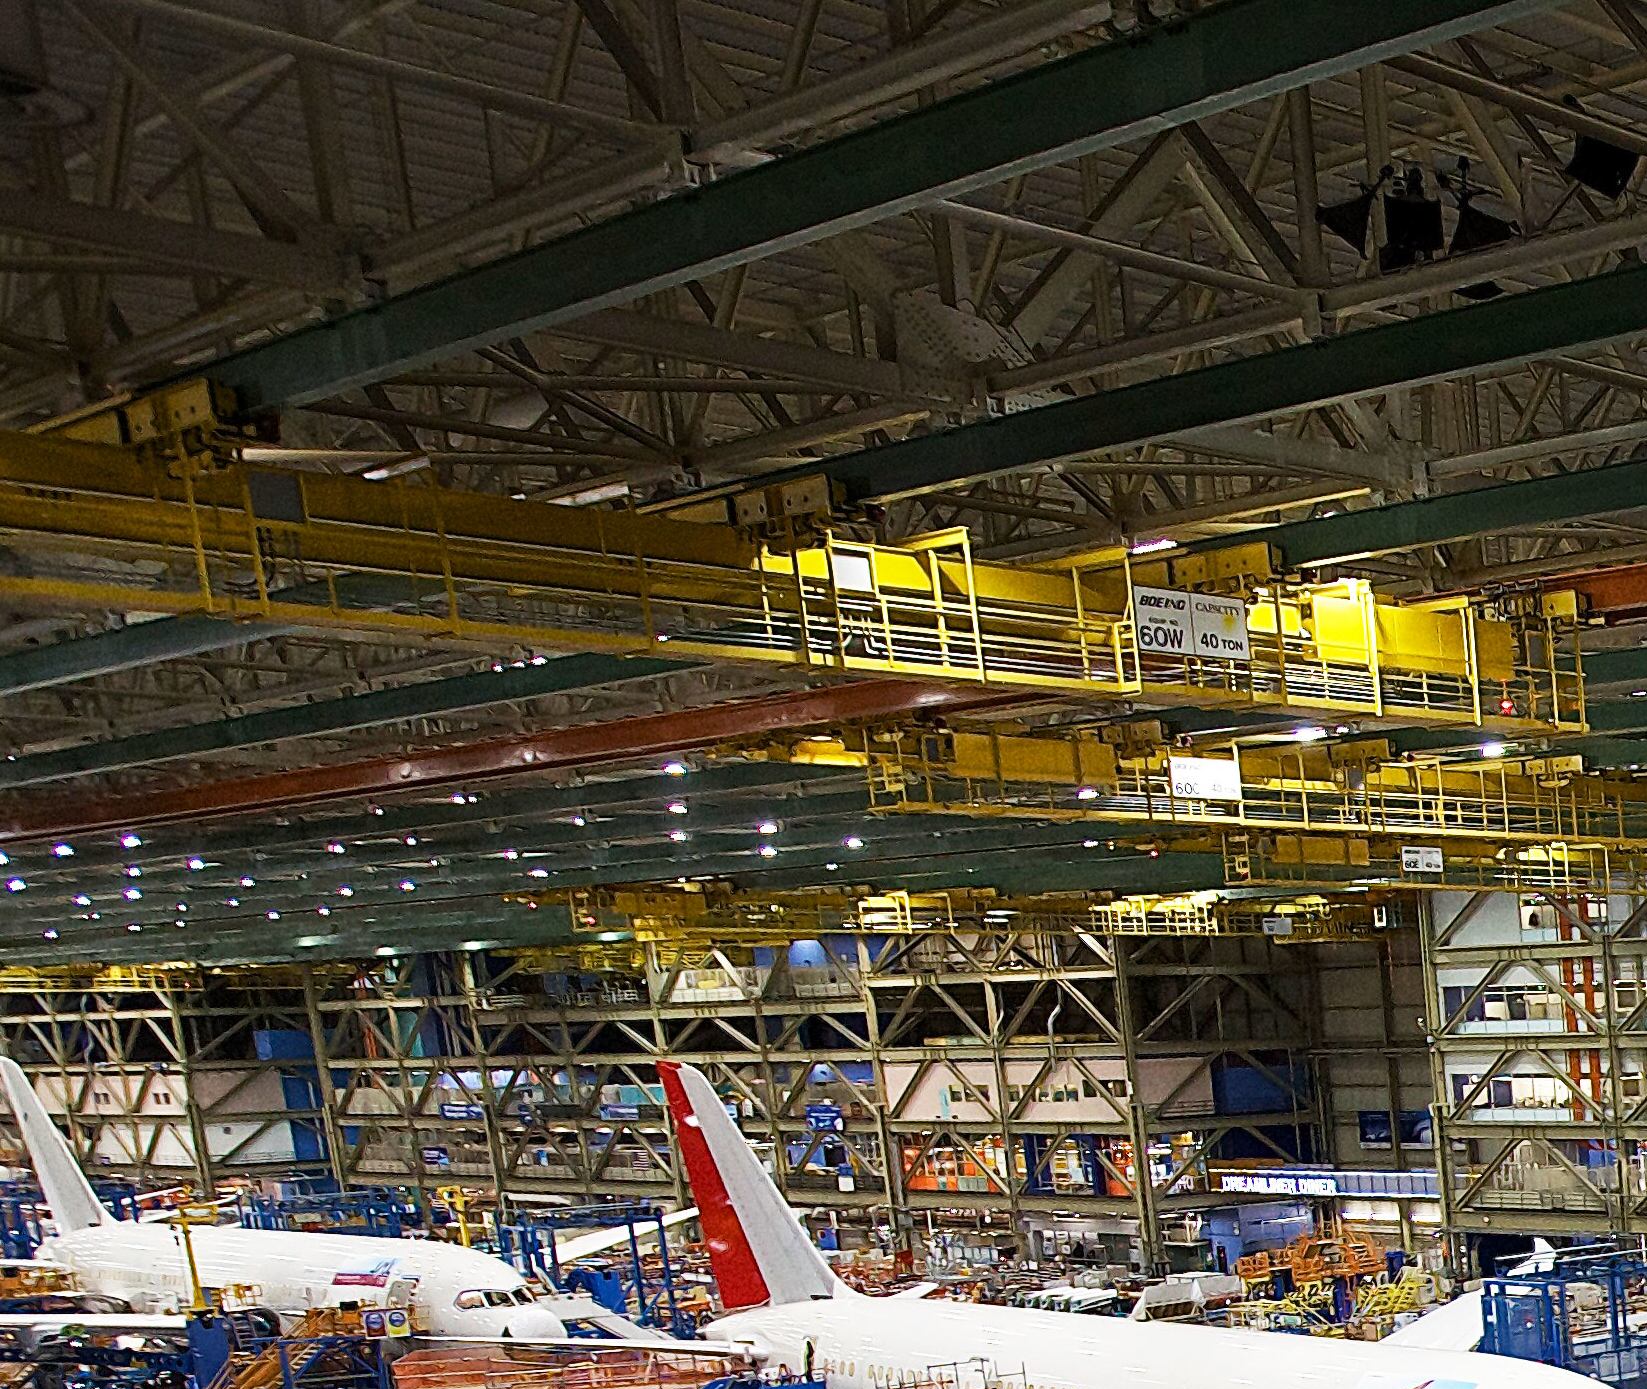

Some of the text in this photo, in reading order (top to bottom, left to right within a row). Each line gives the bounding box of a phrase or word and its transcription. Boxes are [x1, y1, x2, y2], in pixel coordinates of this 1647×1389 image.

[1139, 594, 1186, 611] BOEING
[1139, 625, 1184, 649] 60W
[1200, 632, 1244, 652] 40 TON
